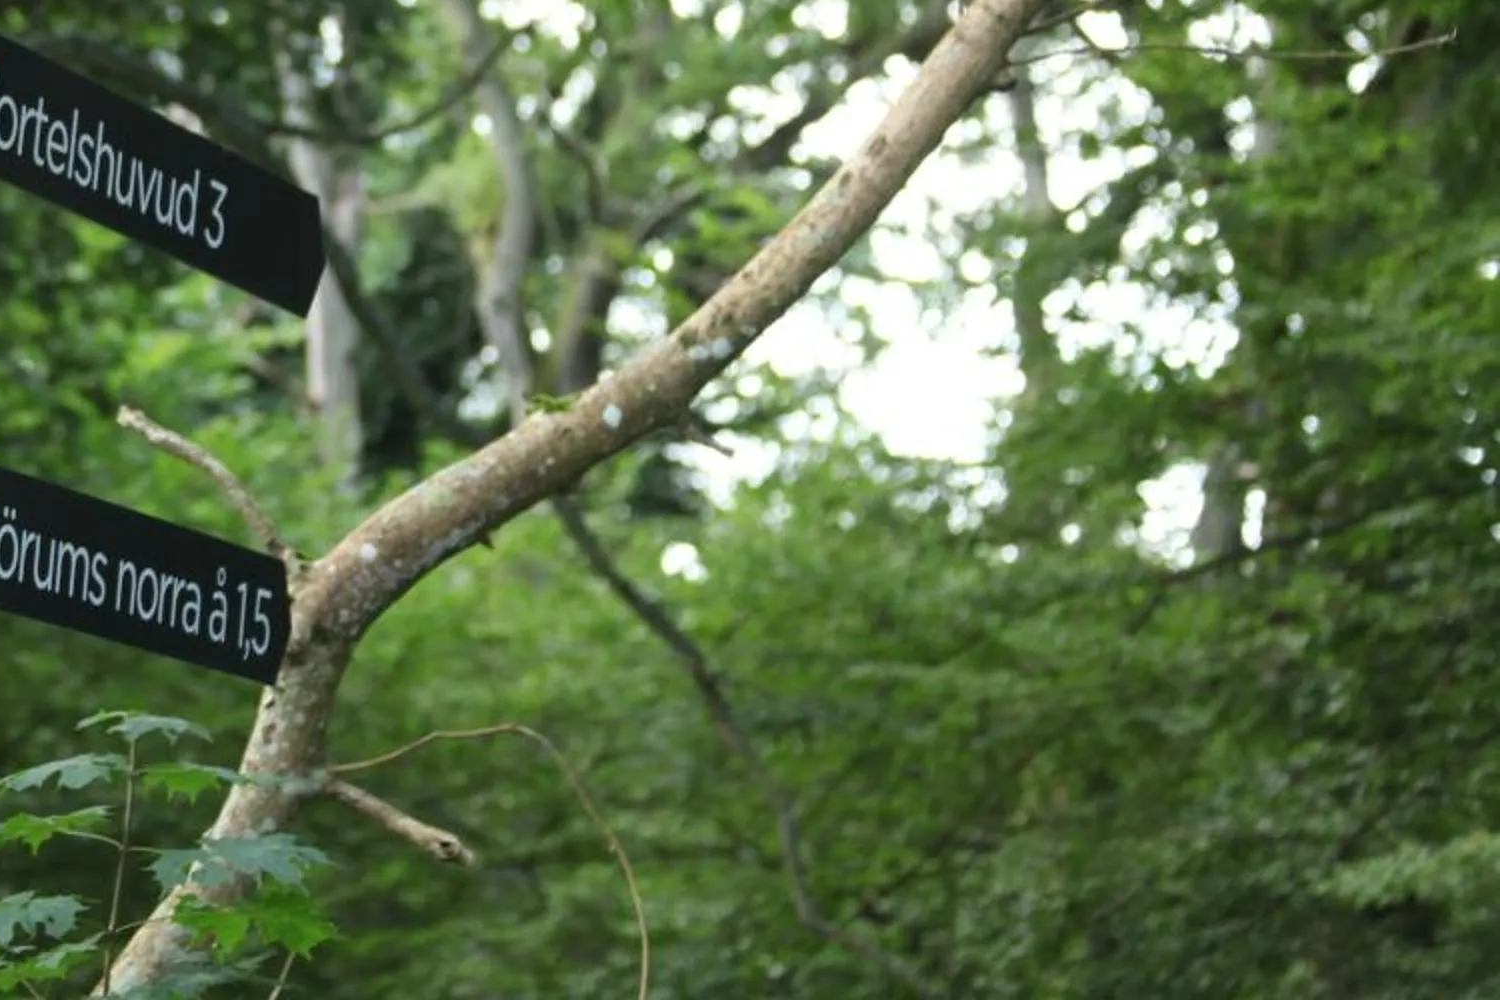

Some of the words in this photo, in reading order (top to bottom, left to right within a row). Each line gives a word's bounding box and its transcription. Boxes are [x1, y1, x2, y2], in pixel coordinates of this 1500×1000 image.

[204, 179, 229, 249] 3
[115, 559, 202, 636] norra
[208, 567, 228, 643] å
[237, 582, 273, 661] 1,5
